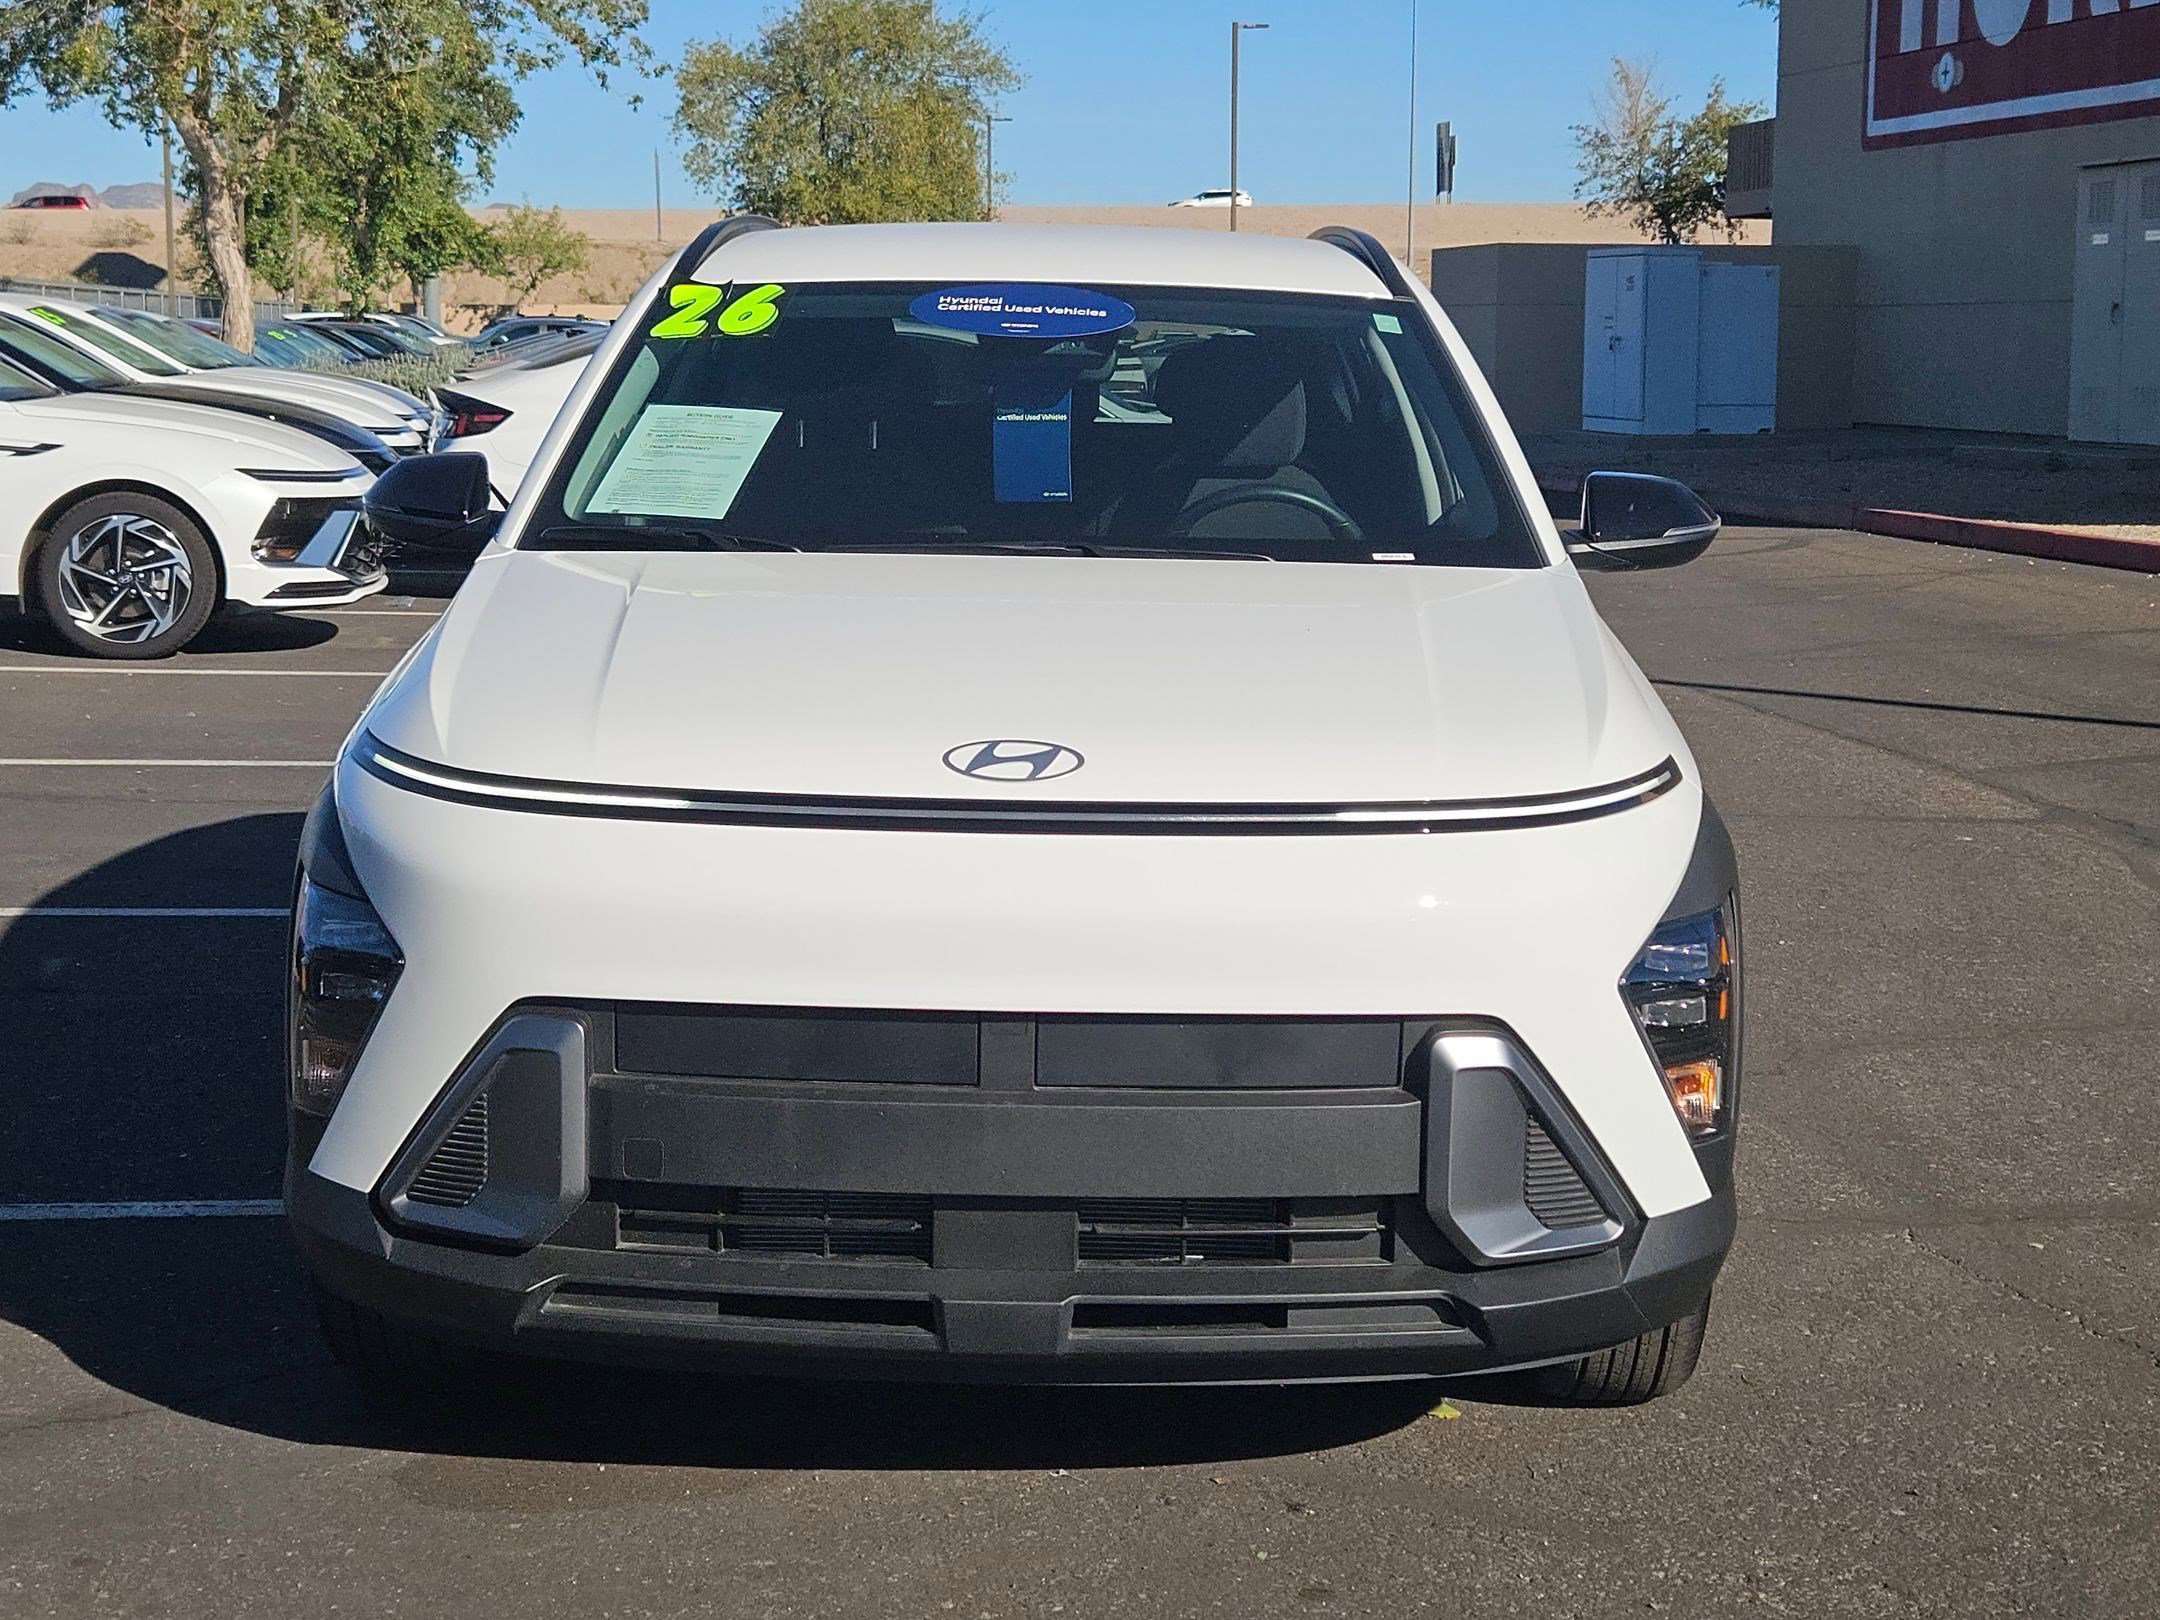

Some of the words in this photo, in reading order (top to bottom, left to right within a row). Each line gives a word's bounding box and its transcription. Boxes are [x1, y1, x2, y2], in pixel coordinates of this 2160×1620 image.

[939, 296, 1003, 304] Hyundai
[650, 284, 785, 339] 26
[937, 304, 1002, 312] Certified
[1004, 304, 1043, 313] Used
[1045, 306, 1107, 317] Vehicles
